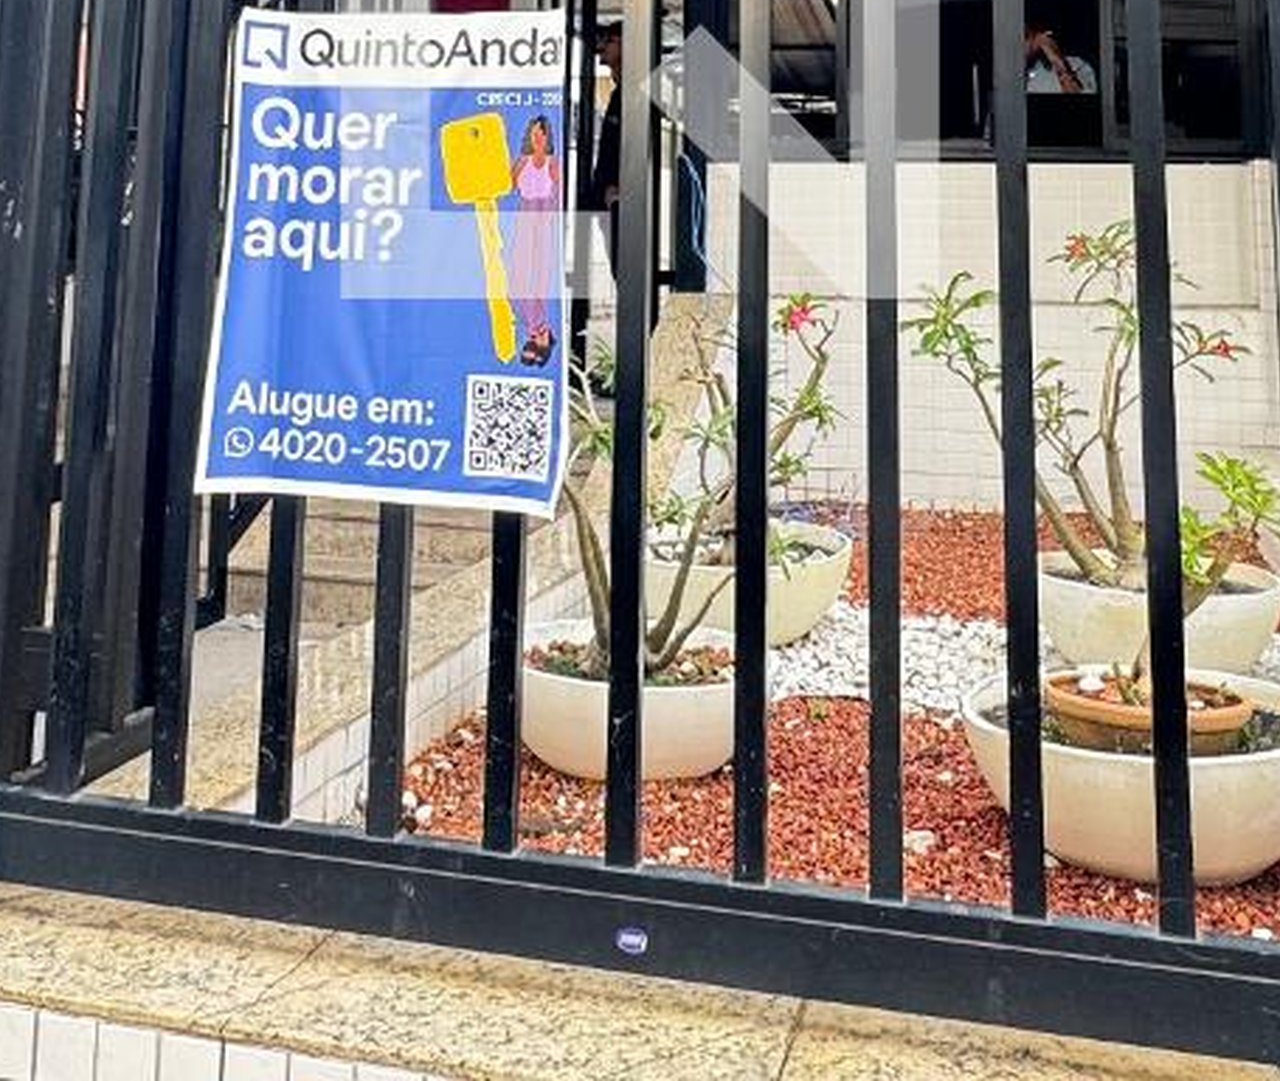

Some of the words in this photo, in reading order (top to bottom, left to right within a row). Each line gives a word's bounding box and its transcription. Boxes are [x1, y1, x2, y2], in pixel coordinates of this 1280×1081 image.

[251, 97, 398, 152] Quer
[247, 162, 423, 206] morar
[243, 209, 403, 271] aqui?
[226, 380, 358, 426] Alugue
[367, 396, 434, 426] em:
